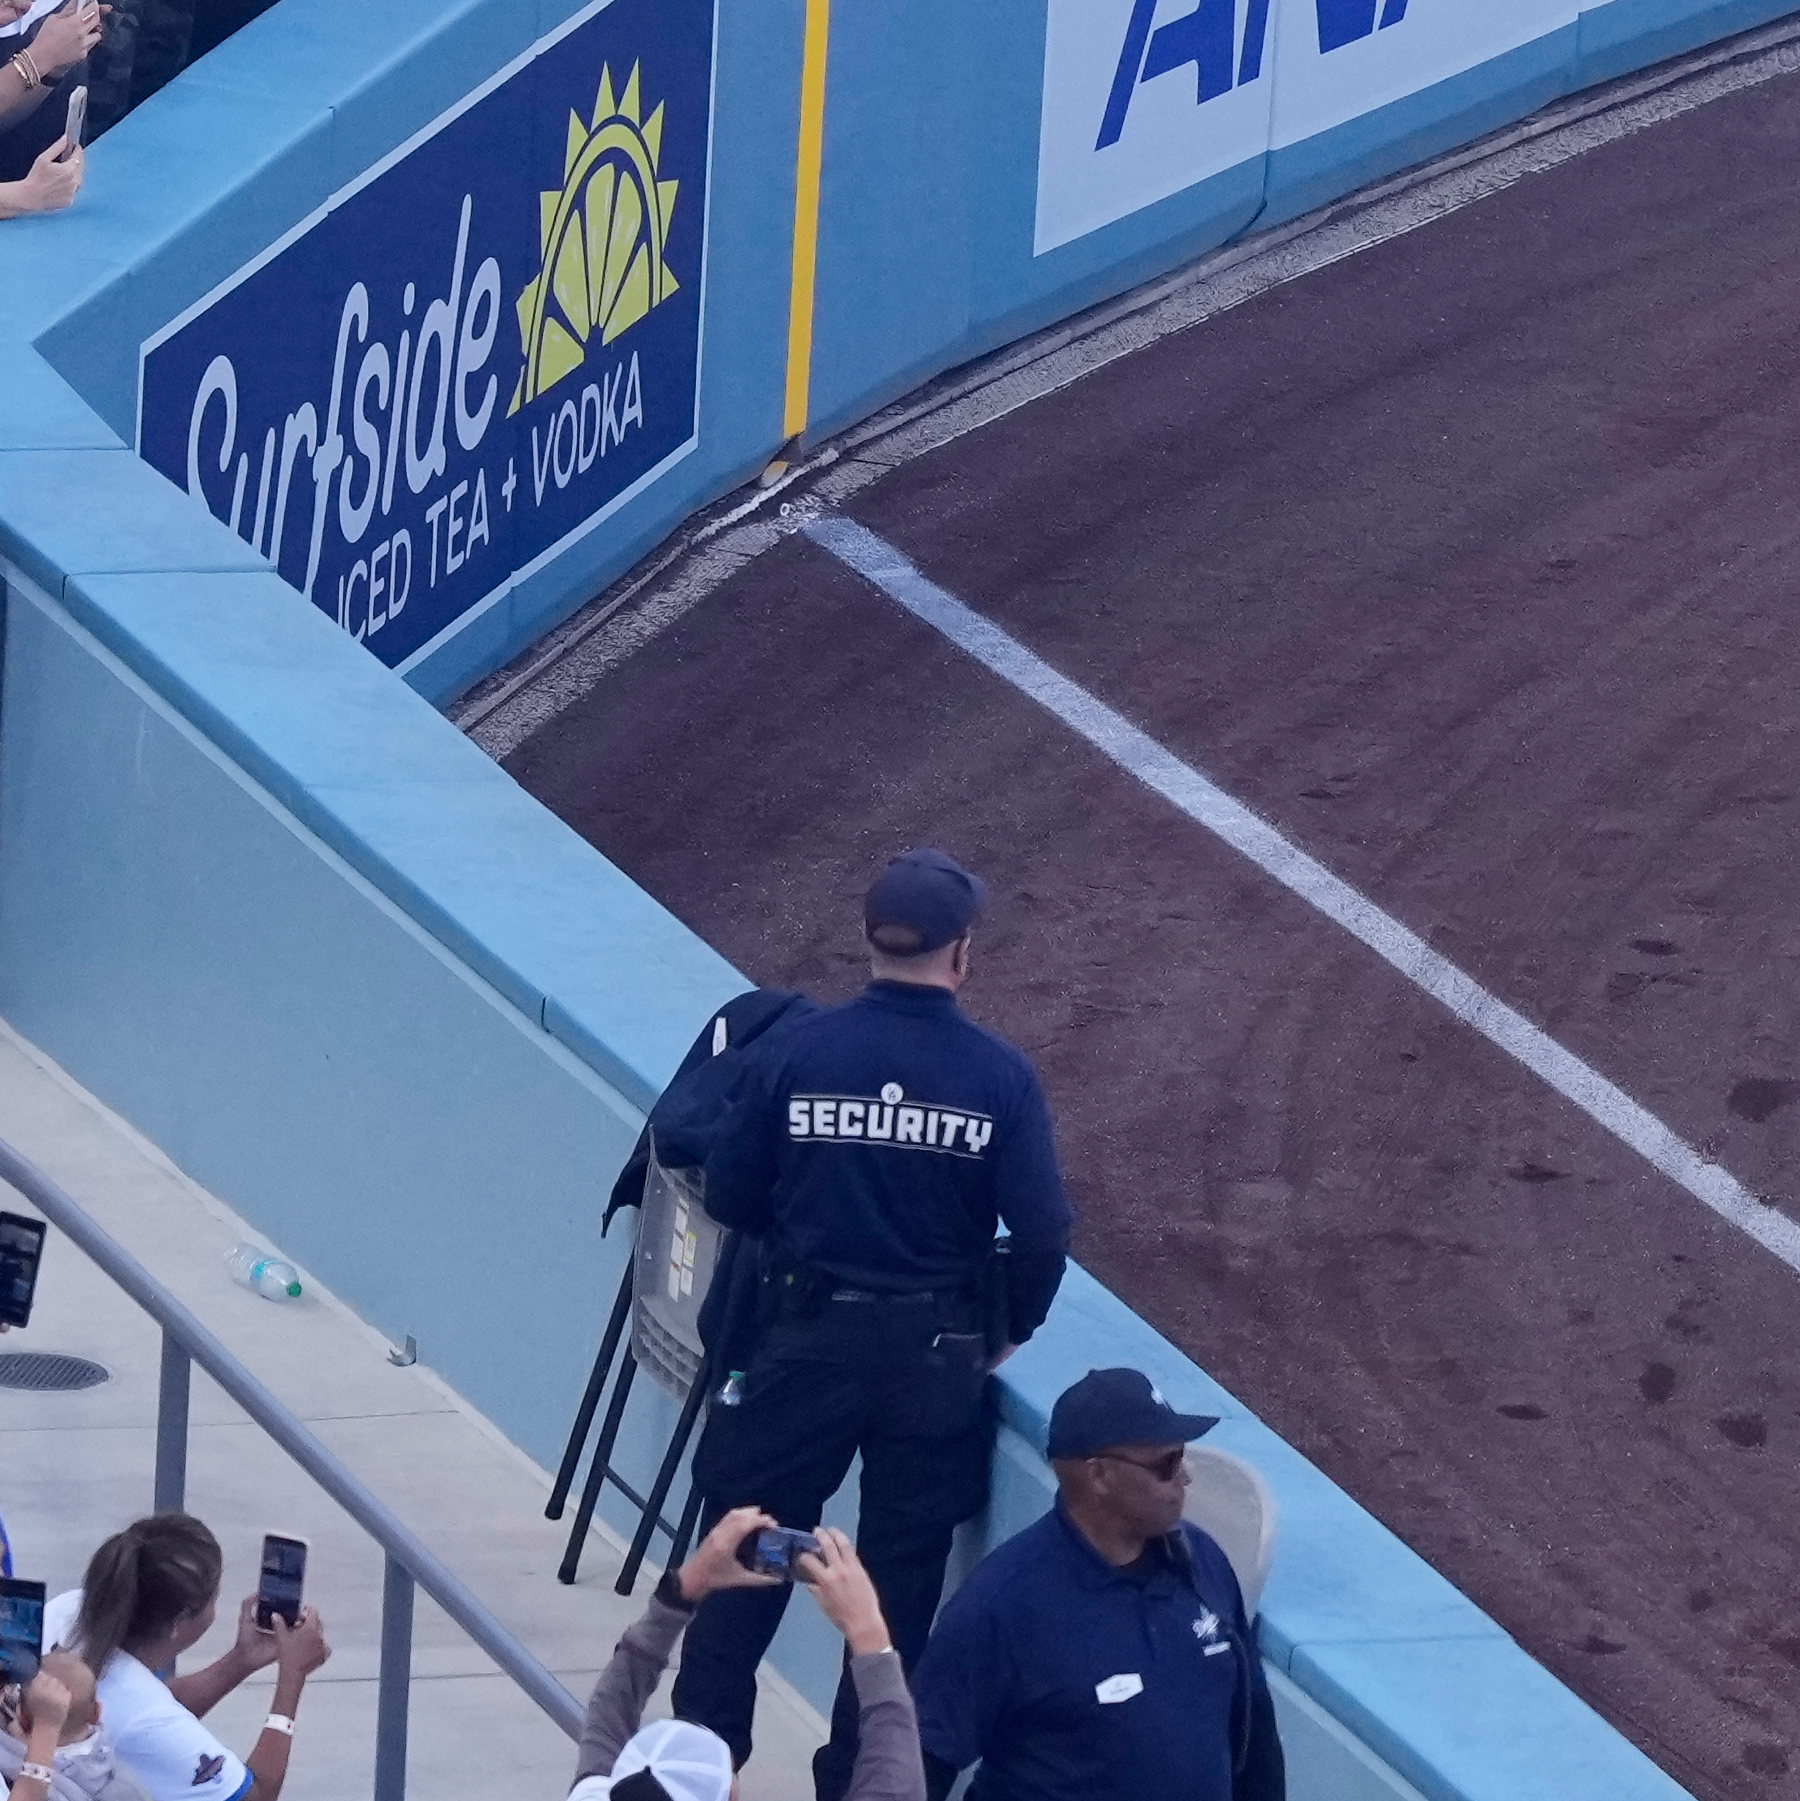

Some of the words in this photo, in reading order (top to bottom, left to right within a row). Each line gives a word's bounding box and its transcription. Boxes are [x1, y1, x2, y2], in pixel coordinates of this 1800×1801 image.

[187, 192, 500, 594] Surfside
[336, 535, 413, 644] ICED
[426, 478, 489, 589] TEA
[531, 350, 644, 508] VODKA
[788, 1099, 993, 1155] SECURITY
